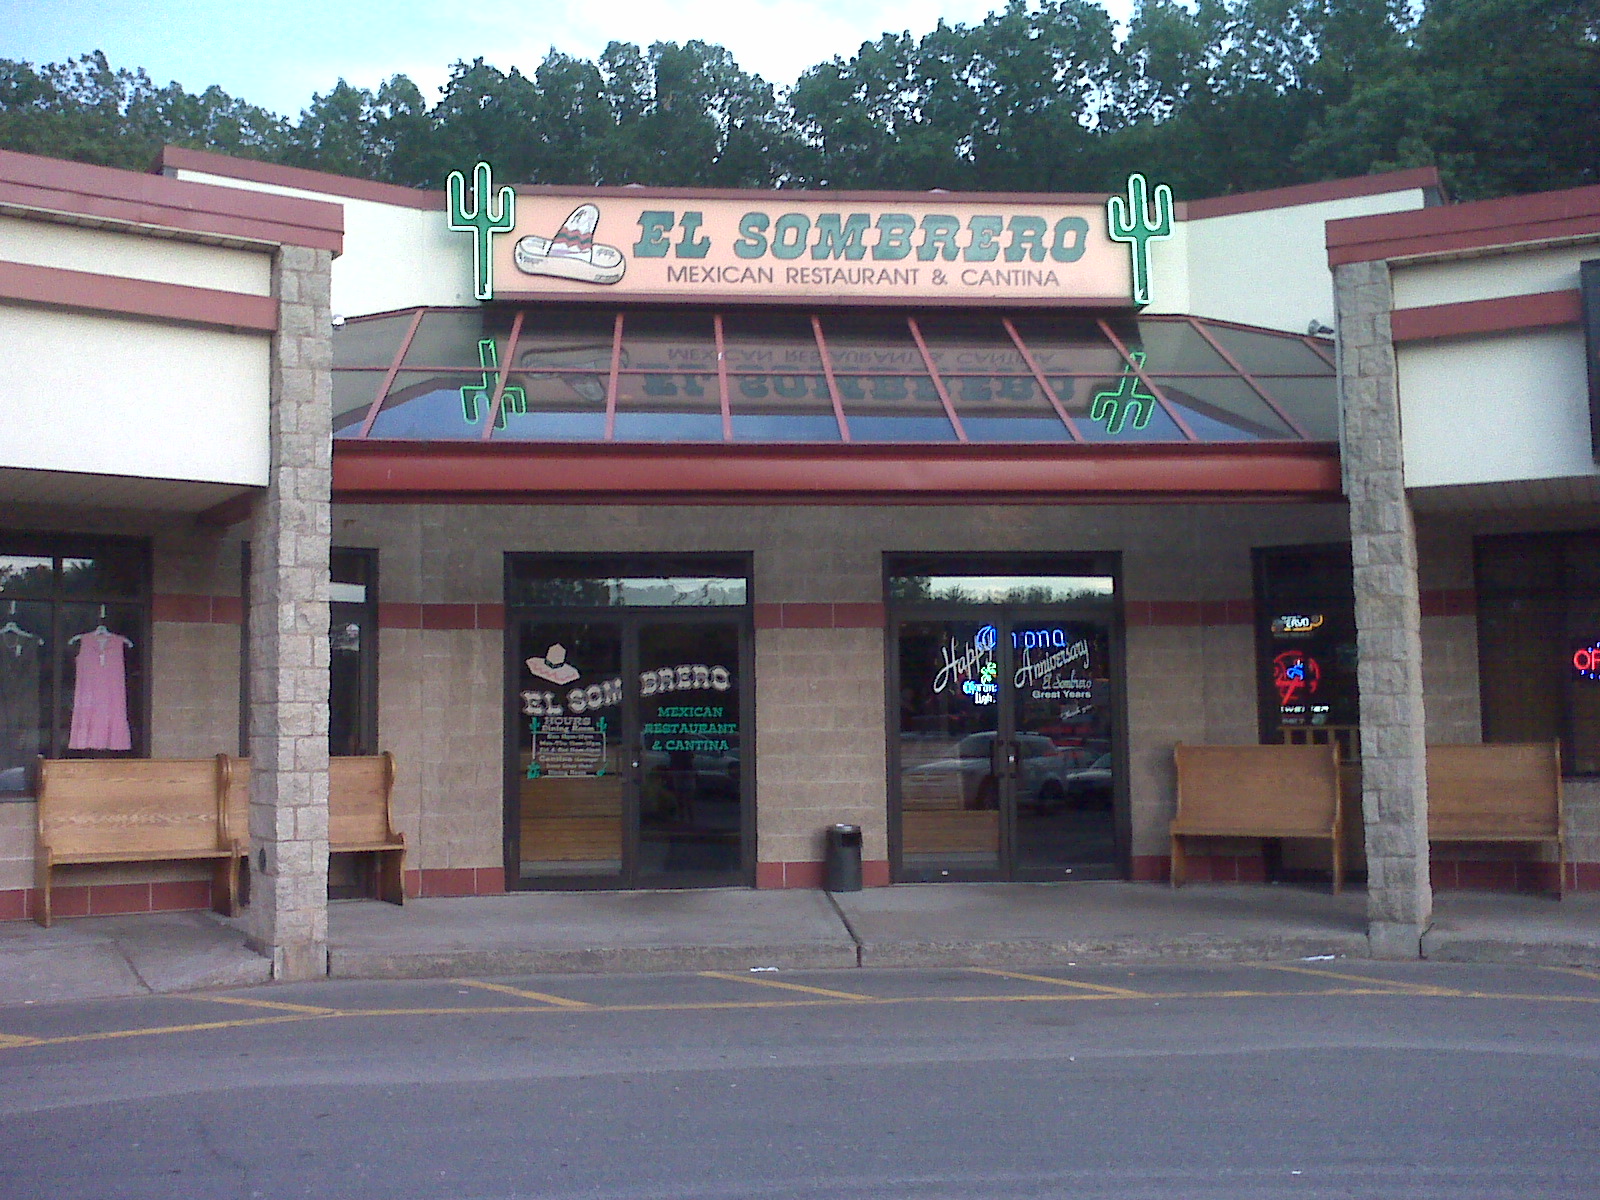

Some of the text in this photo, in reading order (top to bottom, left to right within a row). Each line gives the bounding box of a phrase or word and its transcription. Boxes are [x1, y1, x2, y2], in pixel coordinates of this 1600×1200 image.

[632, 210, 1089, 263] EL SOMBRERO
[667, 266, 1060, 287] MEXICAN RESTAURANT & CANTINA
[1062, 690, 1092, 699] Years
[520, 690, 563, 715] EL
[657, 706, 724, 718] MEXICAN
[544, 716, 592, 726] HOURS
[644, 723, 737, 734] RESTAURANT
[652, 740, 730, 751] & CANTINA
